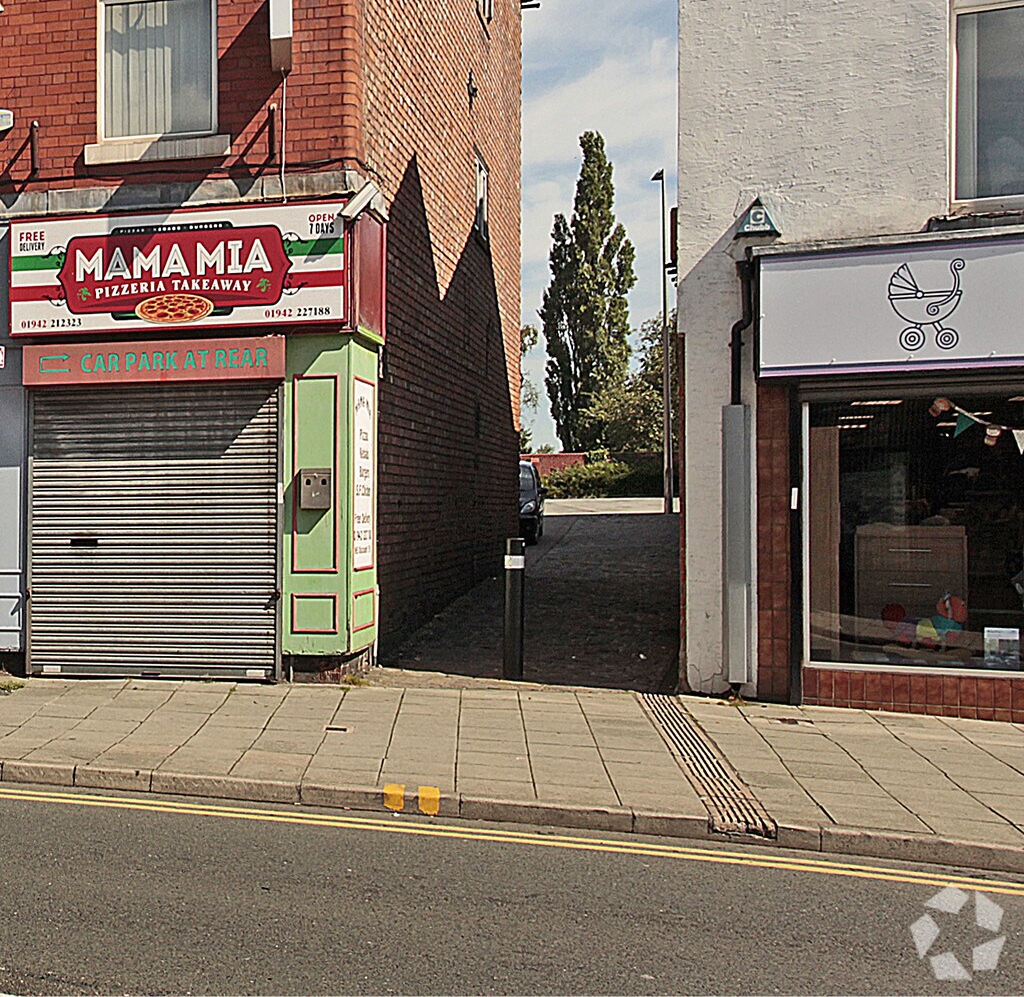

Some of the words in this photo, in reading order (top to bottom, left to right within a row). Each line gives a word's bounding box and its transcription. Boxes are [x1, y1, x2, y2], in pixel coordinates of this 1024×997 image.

[308, 213, 334, 222] OPEN
[309, 224, 314, 234] 7
[316, 223, 334, 234] DAYS
[19, 231, 45, 241] FREE
[19, 242, 45, 251] DELIVERY
[76, 243, 190, 282] MAMA
[196, 239, 273, 276] MIA
[95, 280, 166, 299] PIZZERIA
[171, 278, 252, 292] TAKEAWAY
[265, 309, 292, 318] 01942
[297, 307, 330, 316] 227188
[21, 319, 47, 329] 01942
[50, 318, 82, 328] 212323
[80, 352, 120, 373] CAR
[126, 351, 177, 372] PARK
[183, 349, 209, 370] AT
[215, 347, 269, 369] REAR
